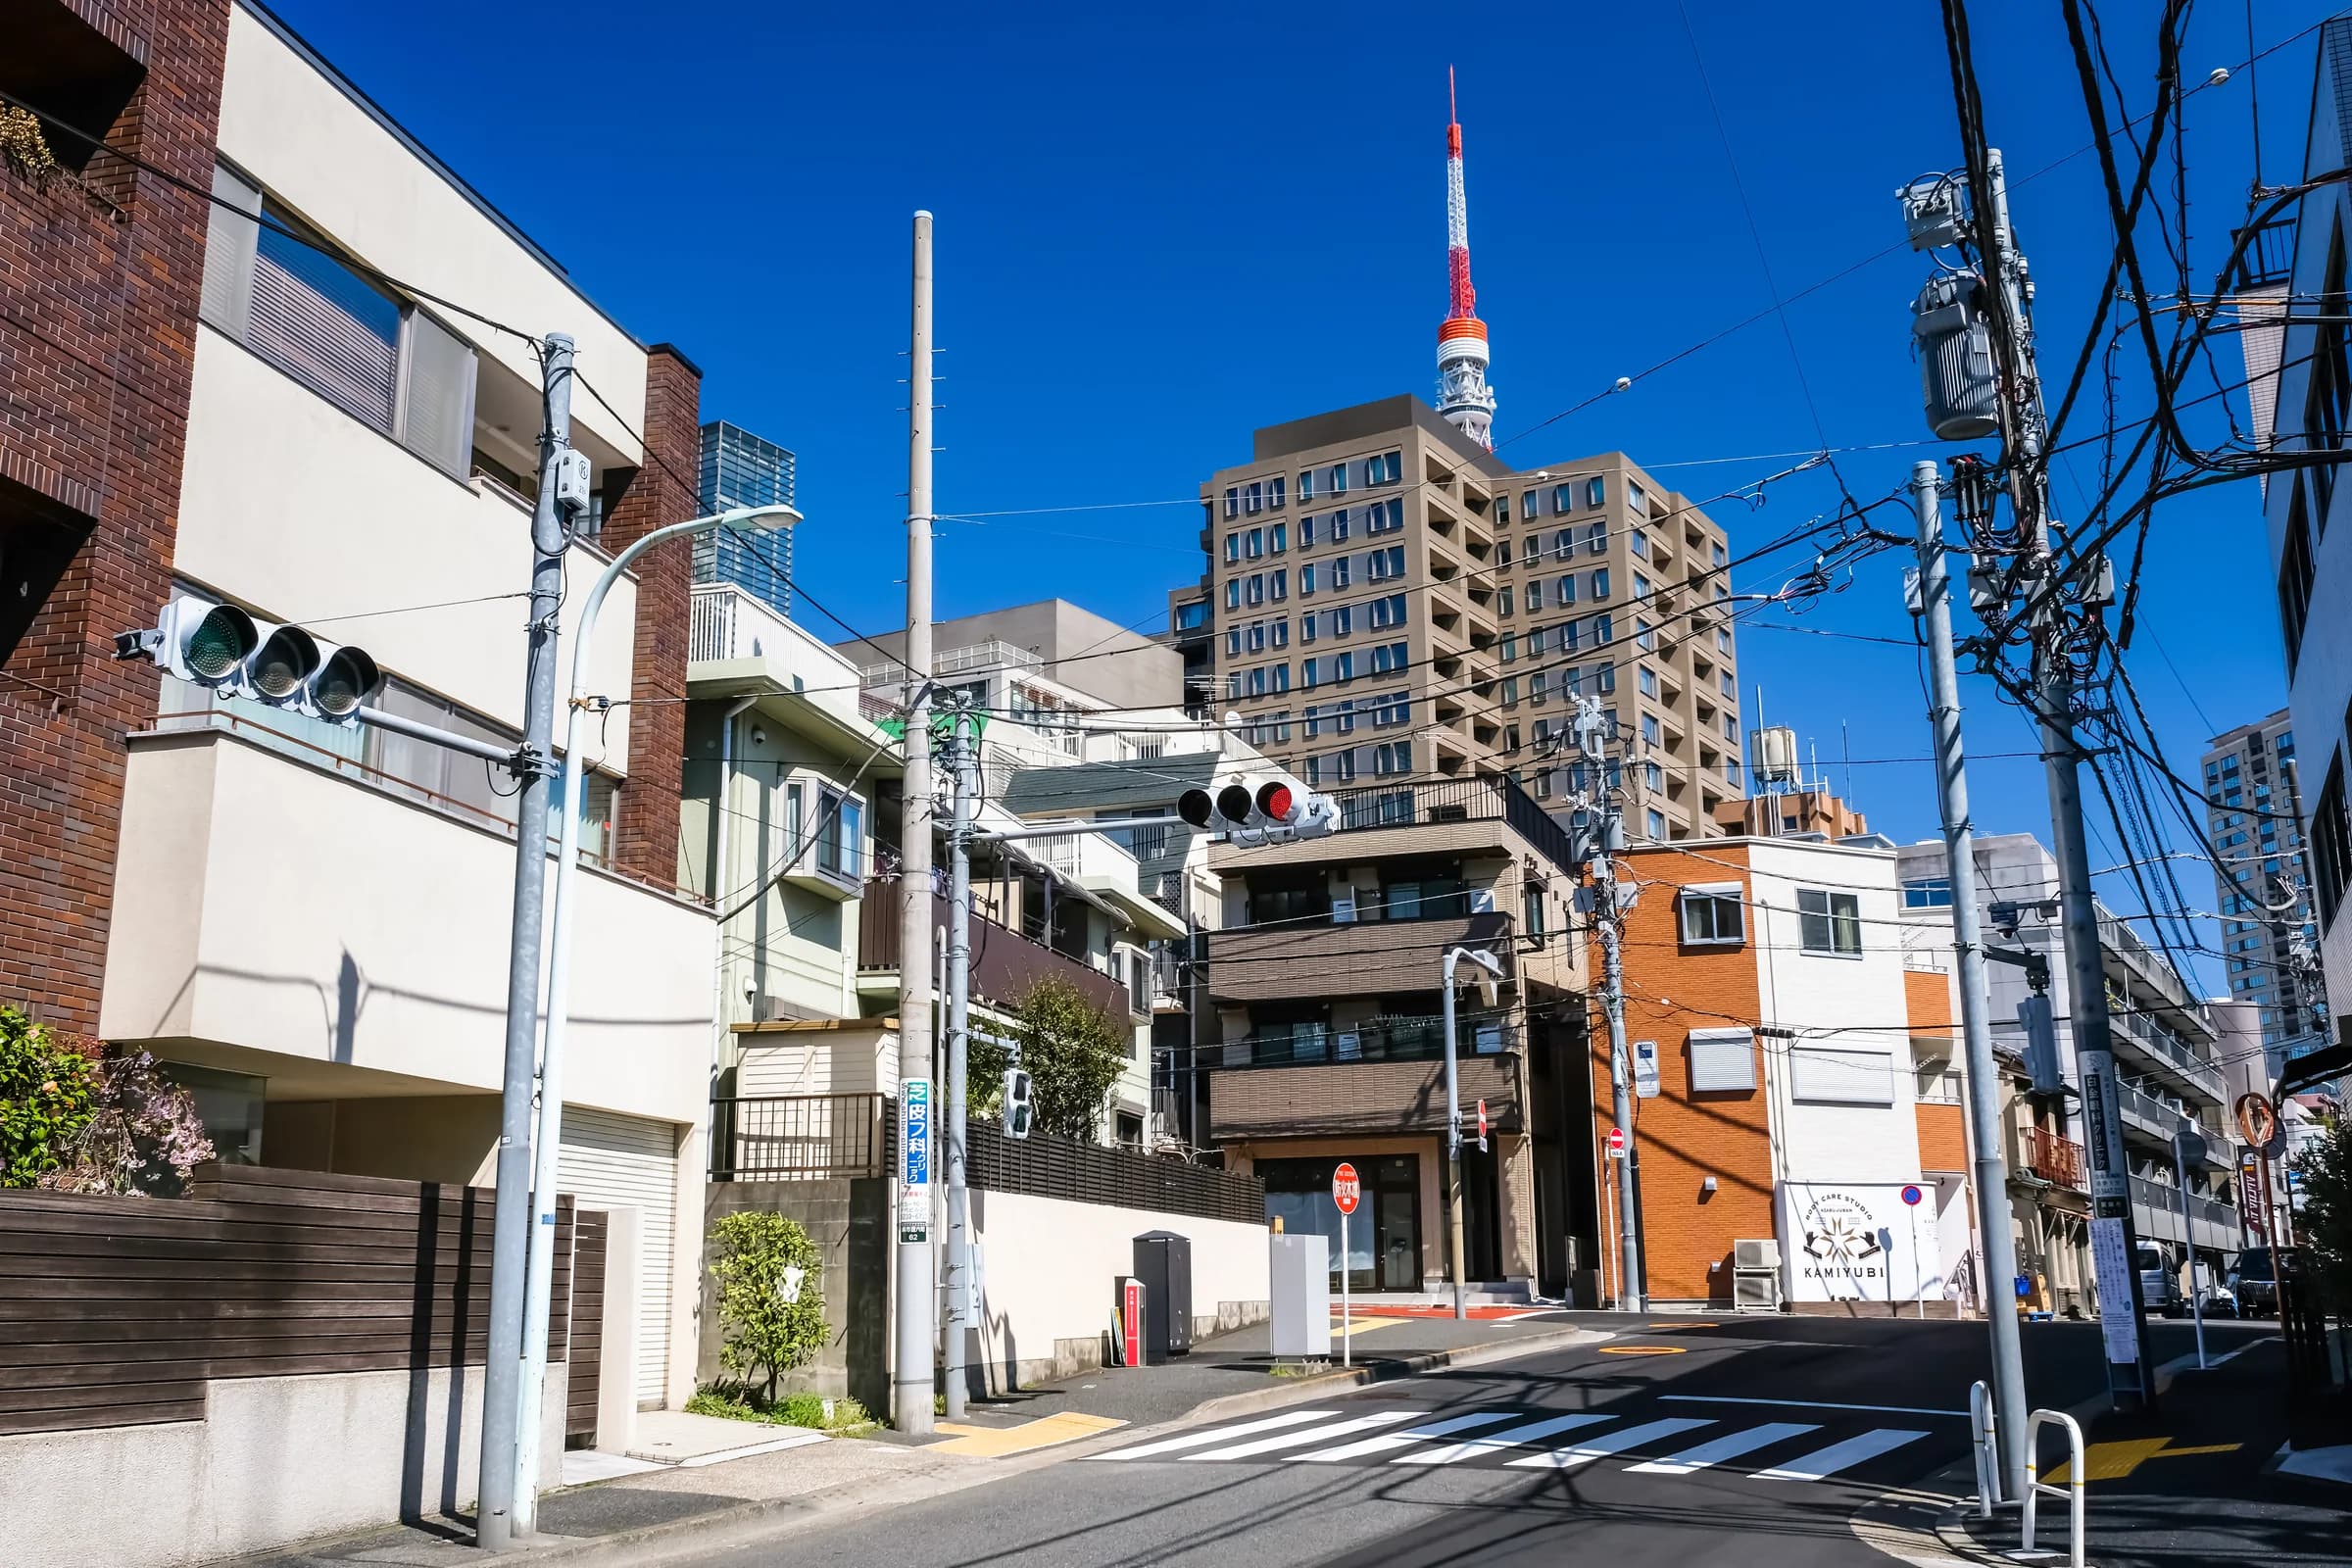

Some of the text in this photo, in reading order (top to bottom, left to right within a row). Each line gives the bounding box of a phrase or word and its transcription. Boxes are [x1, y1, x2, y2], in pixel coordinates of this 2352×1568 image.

[1805, 1193, 1873, 1220] BODY CARE STUDIO
[1804, 1266, 1884, 1278] KAMIYUBI
